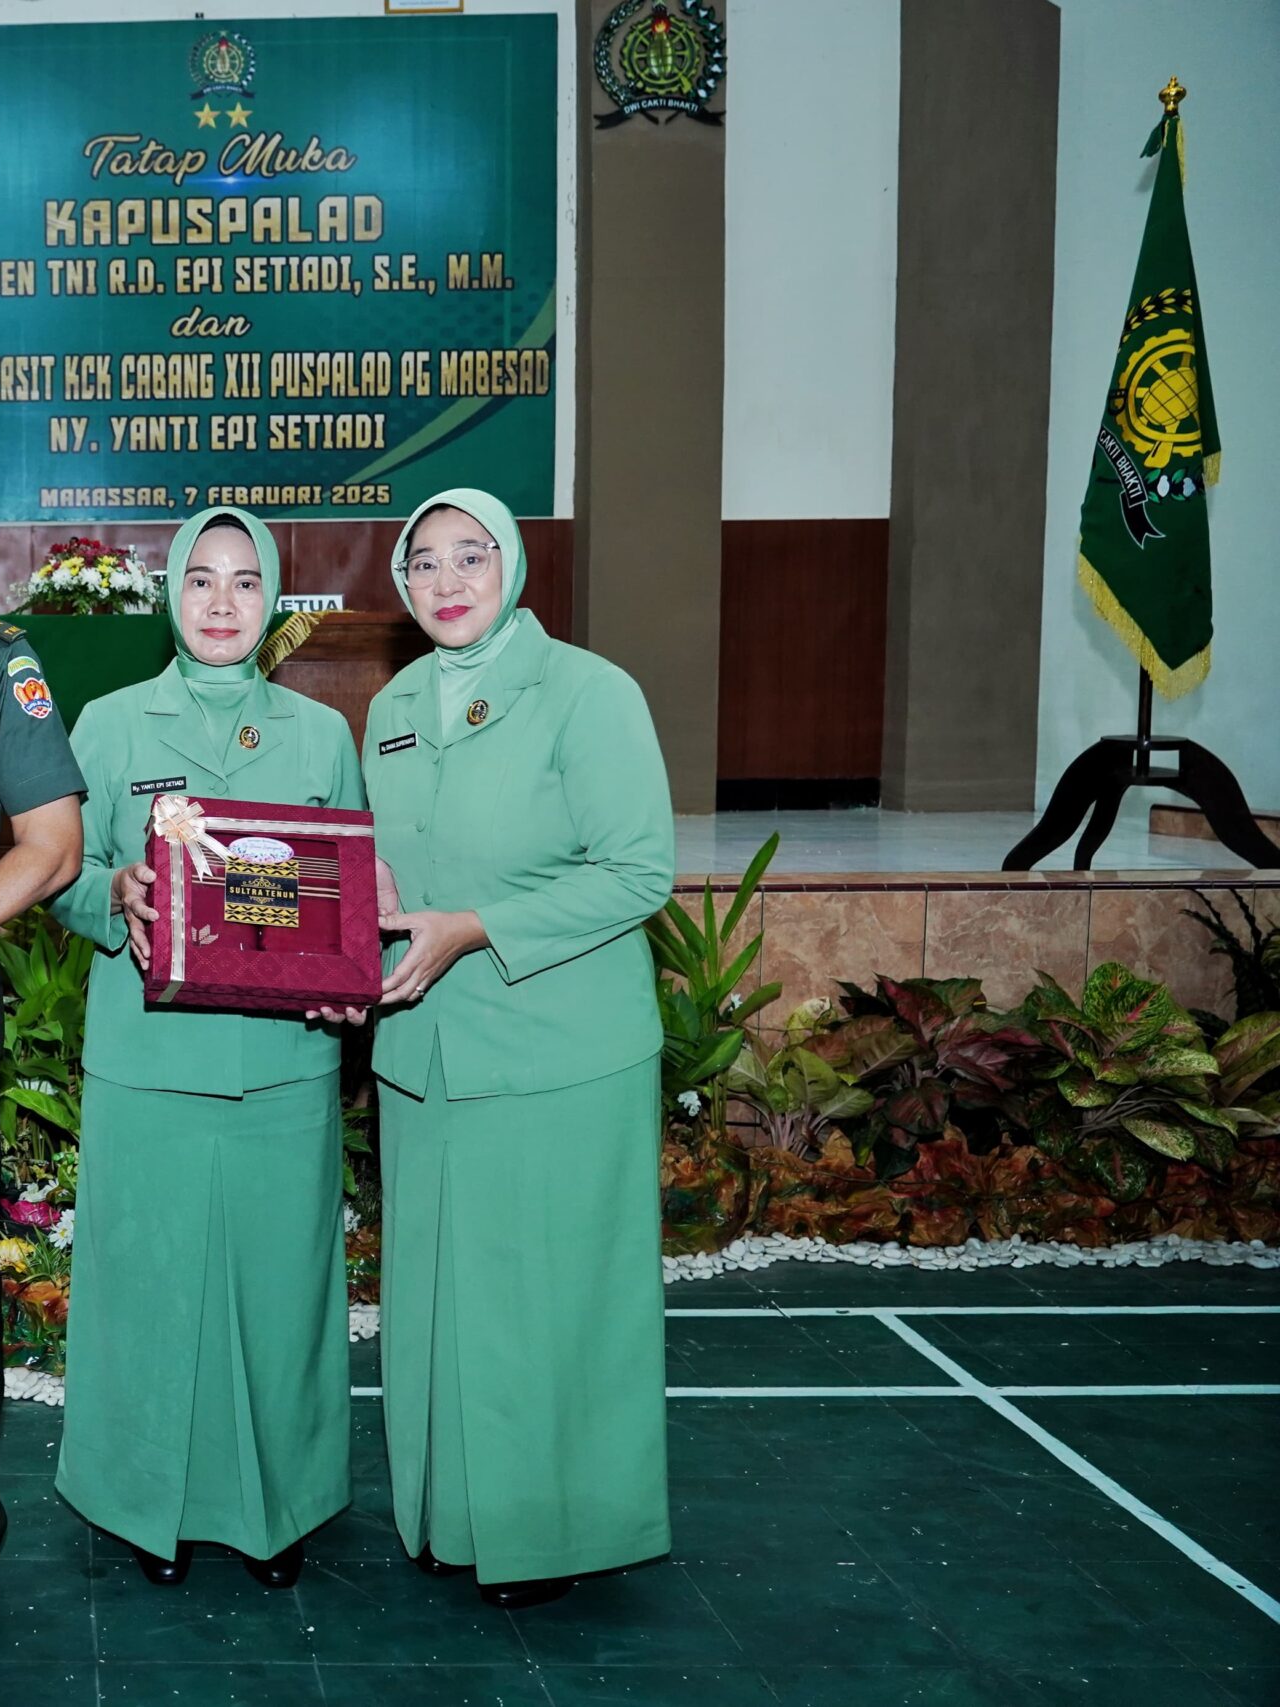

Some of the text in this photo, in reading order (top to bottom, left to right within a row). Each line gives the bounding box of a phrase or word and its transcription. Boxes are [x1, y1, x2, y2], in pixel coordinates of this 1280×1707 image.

[623, 98, 699, 114] DWI CAKTI BHAKTI
[84, 131, 357, 186] Tatap Muka
[45, 195, 384, 247] KAPUSPALAD
[47, 259, 97, 295] TNI
[108, 258, 166, 294] R.D.
[175, 257, 223, 293] EPI
[234, 255, 363, 296] SETIADI,
[373, 254, 437, 295] S.E.,
[448, 253, 514, 290] M.M.
[171, 306, 252, 337] dan
[63, 354, 113, 400] KCK
[120, 353, 215, 400] CABANG
[223, 352, 262, 398] XII
[270, 351, 392, 398] PUSPALAD
[400, 351, 431, 396] PG
[439, 350, 550, 395] MABESAD
[49, 413, 386, 453] NY. YANTI EPI SETIADI
[1099, 429, 1143, 500] CAKTI BHAKTI
[40, 485, 391, 508] MAKASSAR, 7 FEBRUARI 2025
[276, 599, 338, 612] ETUA
[140, 783, 155, 791] YANTI
[165, 779, 185, 788] SETIADI
[229, 886, 295, 899] SULTRA TENUN
